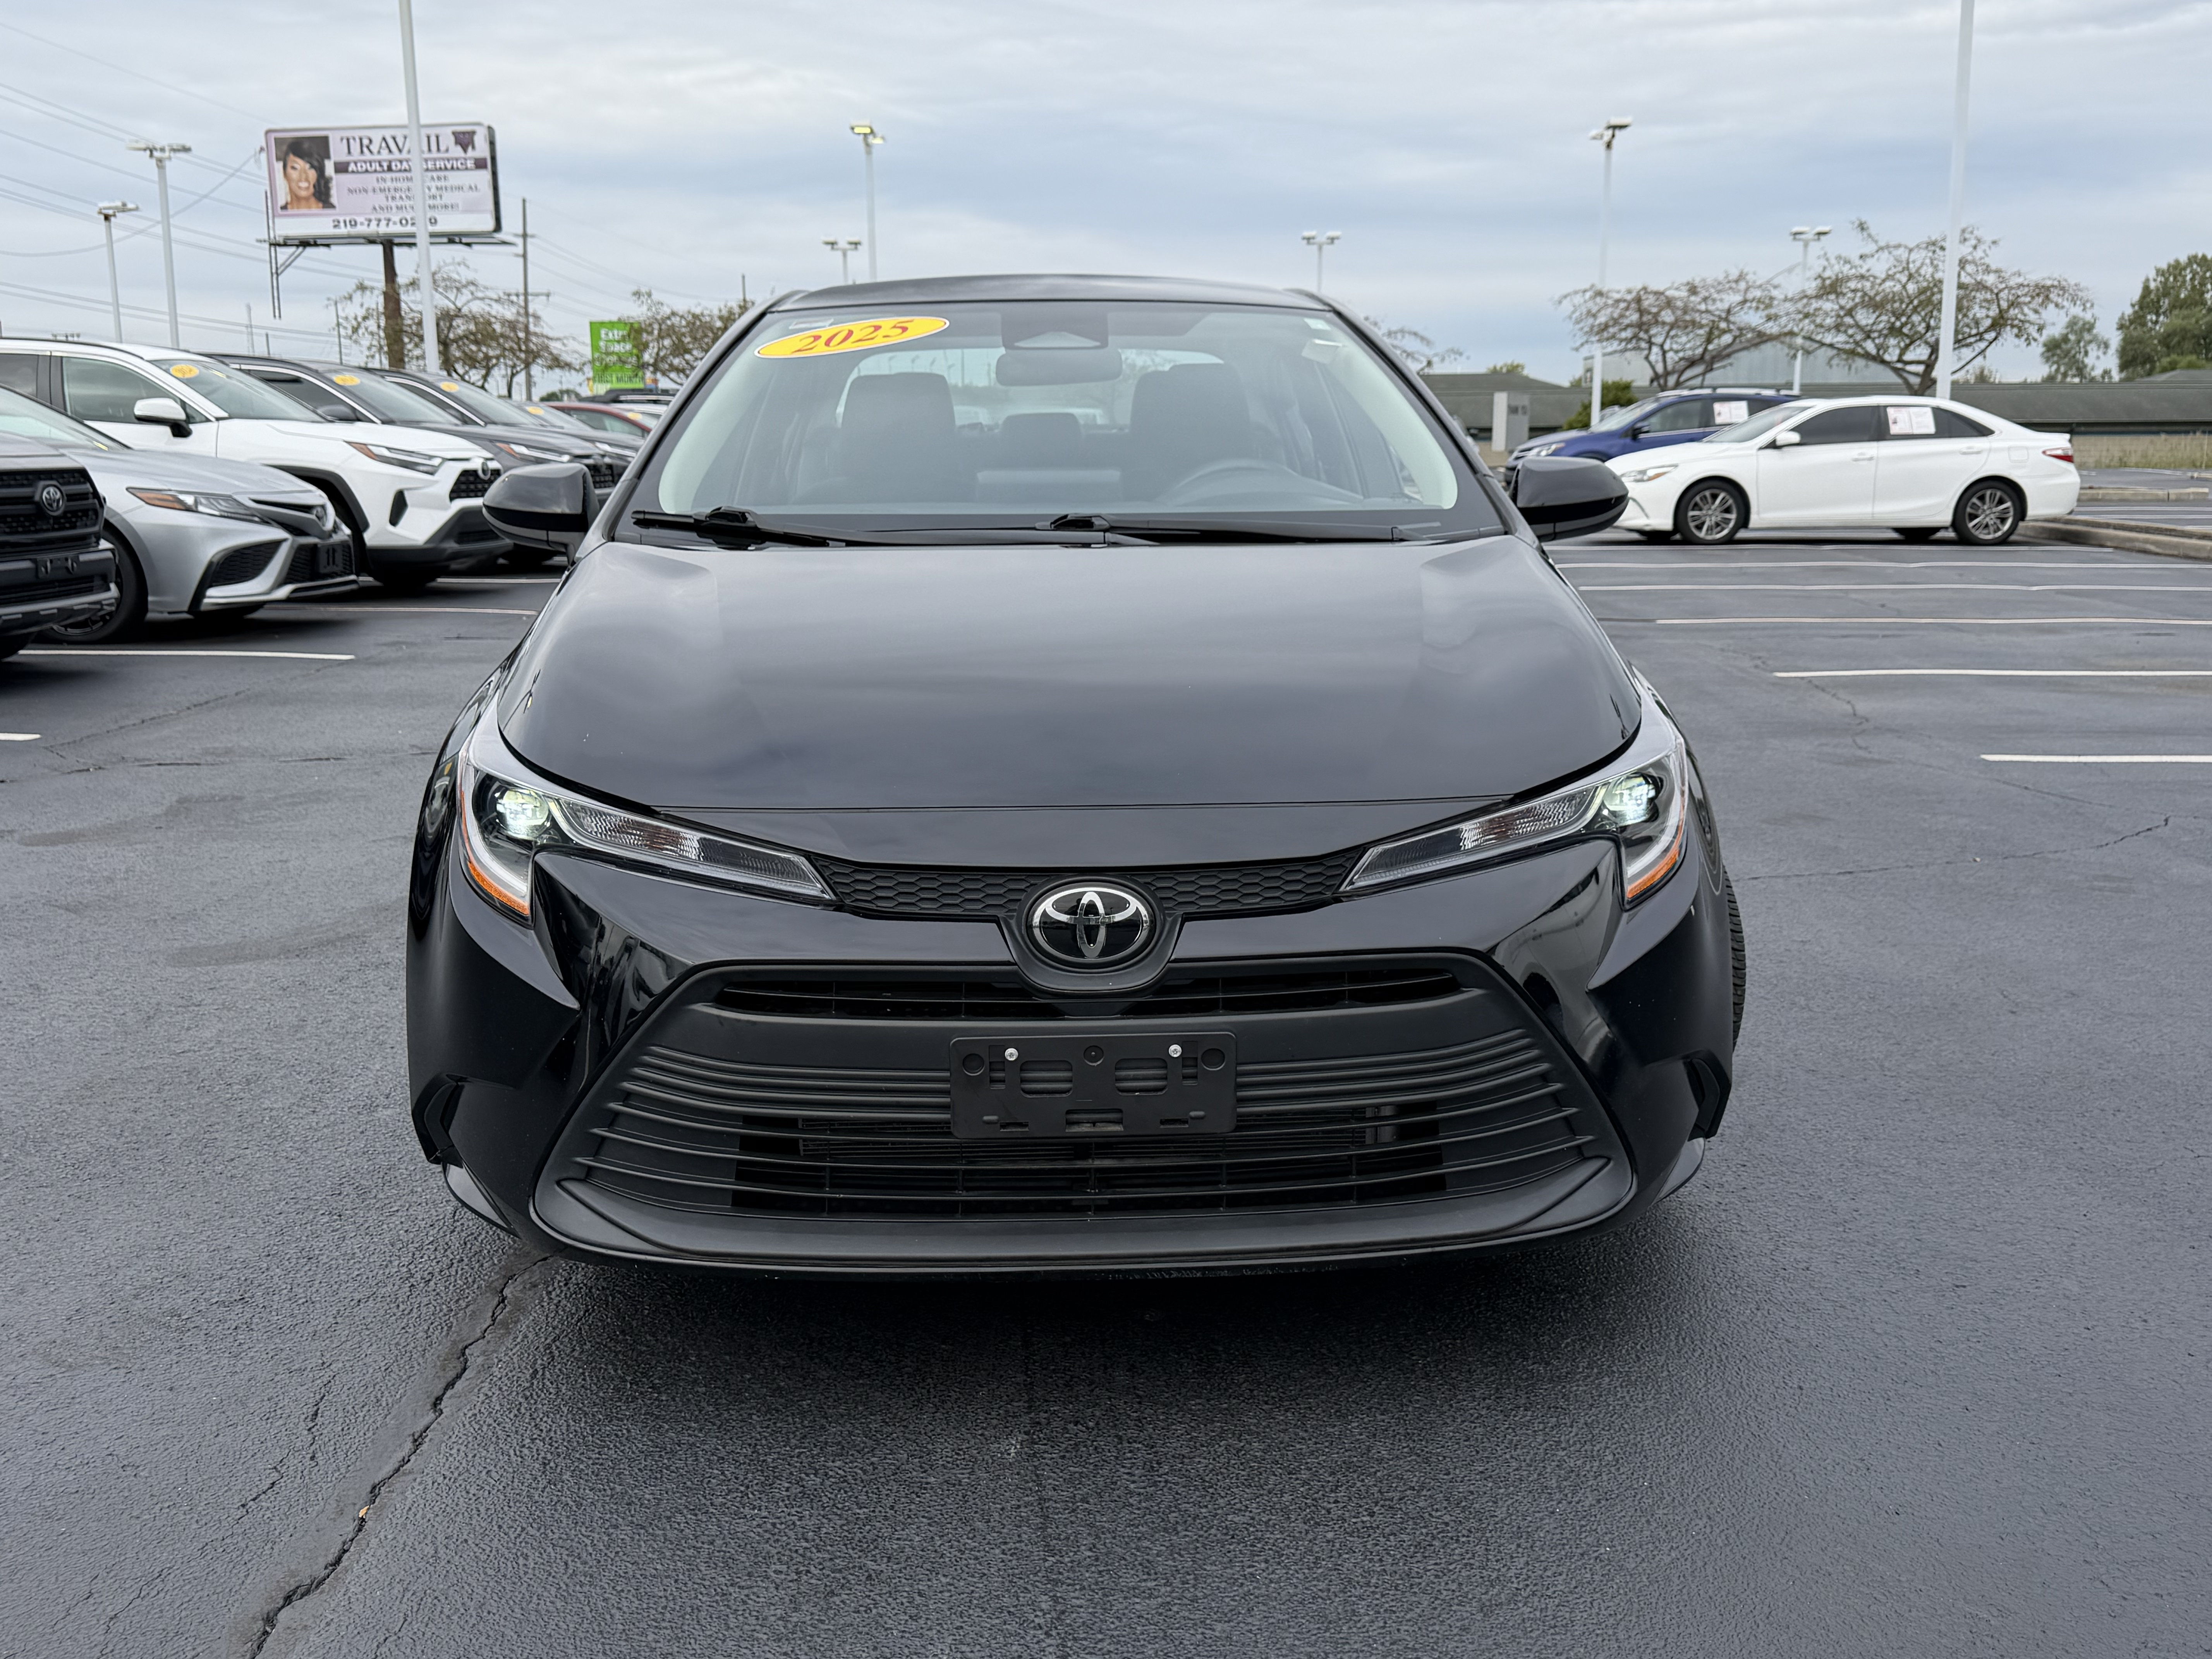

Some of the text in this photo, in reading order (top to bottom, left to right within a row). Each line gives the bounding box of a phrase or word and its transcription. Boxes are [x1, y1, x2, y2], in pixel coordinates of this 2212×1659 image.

[340, 133, 449, 156] TRAVIL
[348, 161, 389, 173] ADULT
[390, 175, 413, 184] HOM
[332, 216, 438, 229] 219-777-029
[791, 319, 915, 353] 2025
